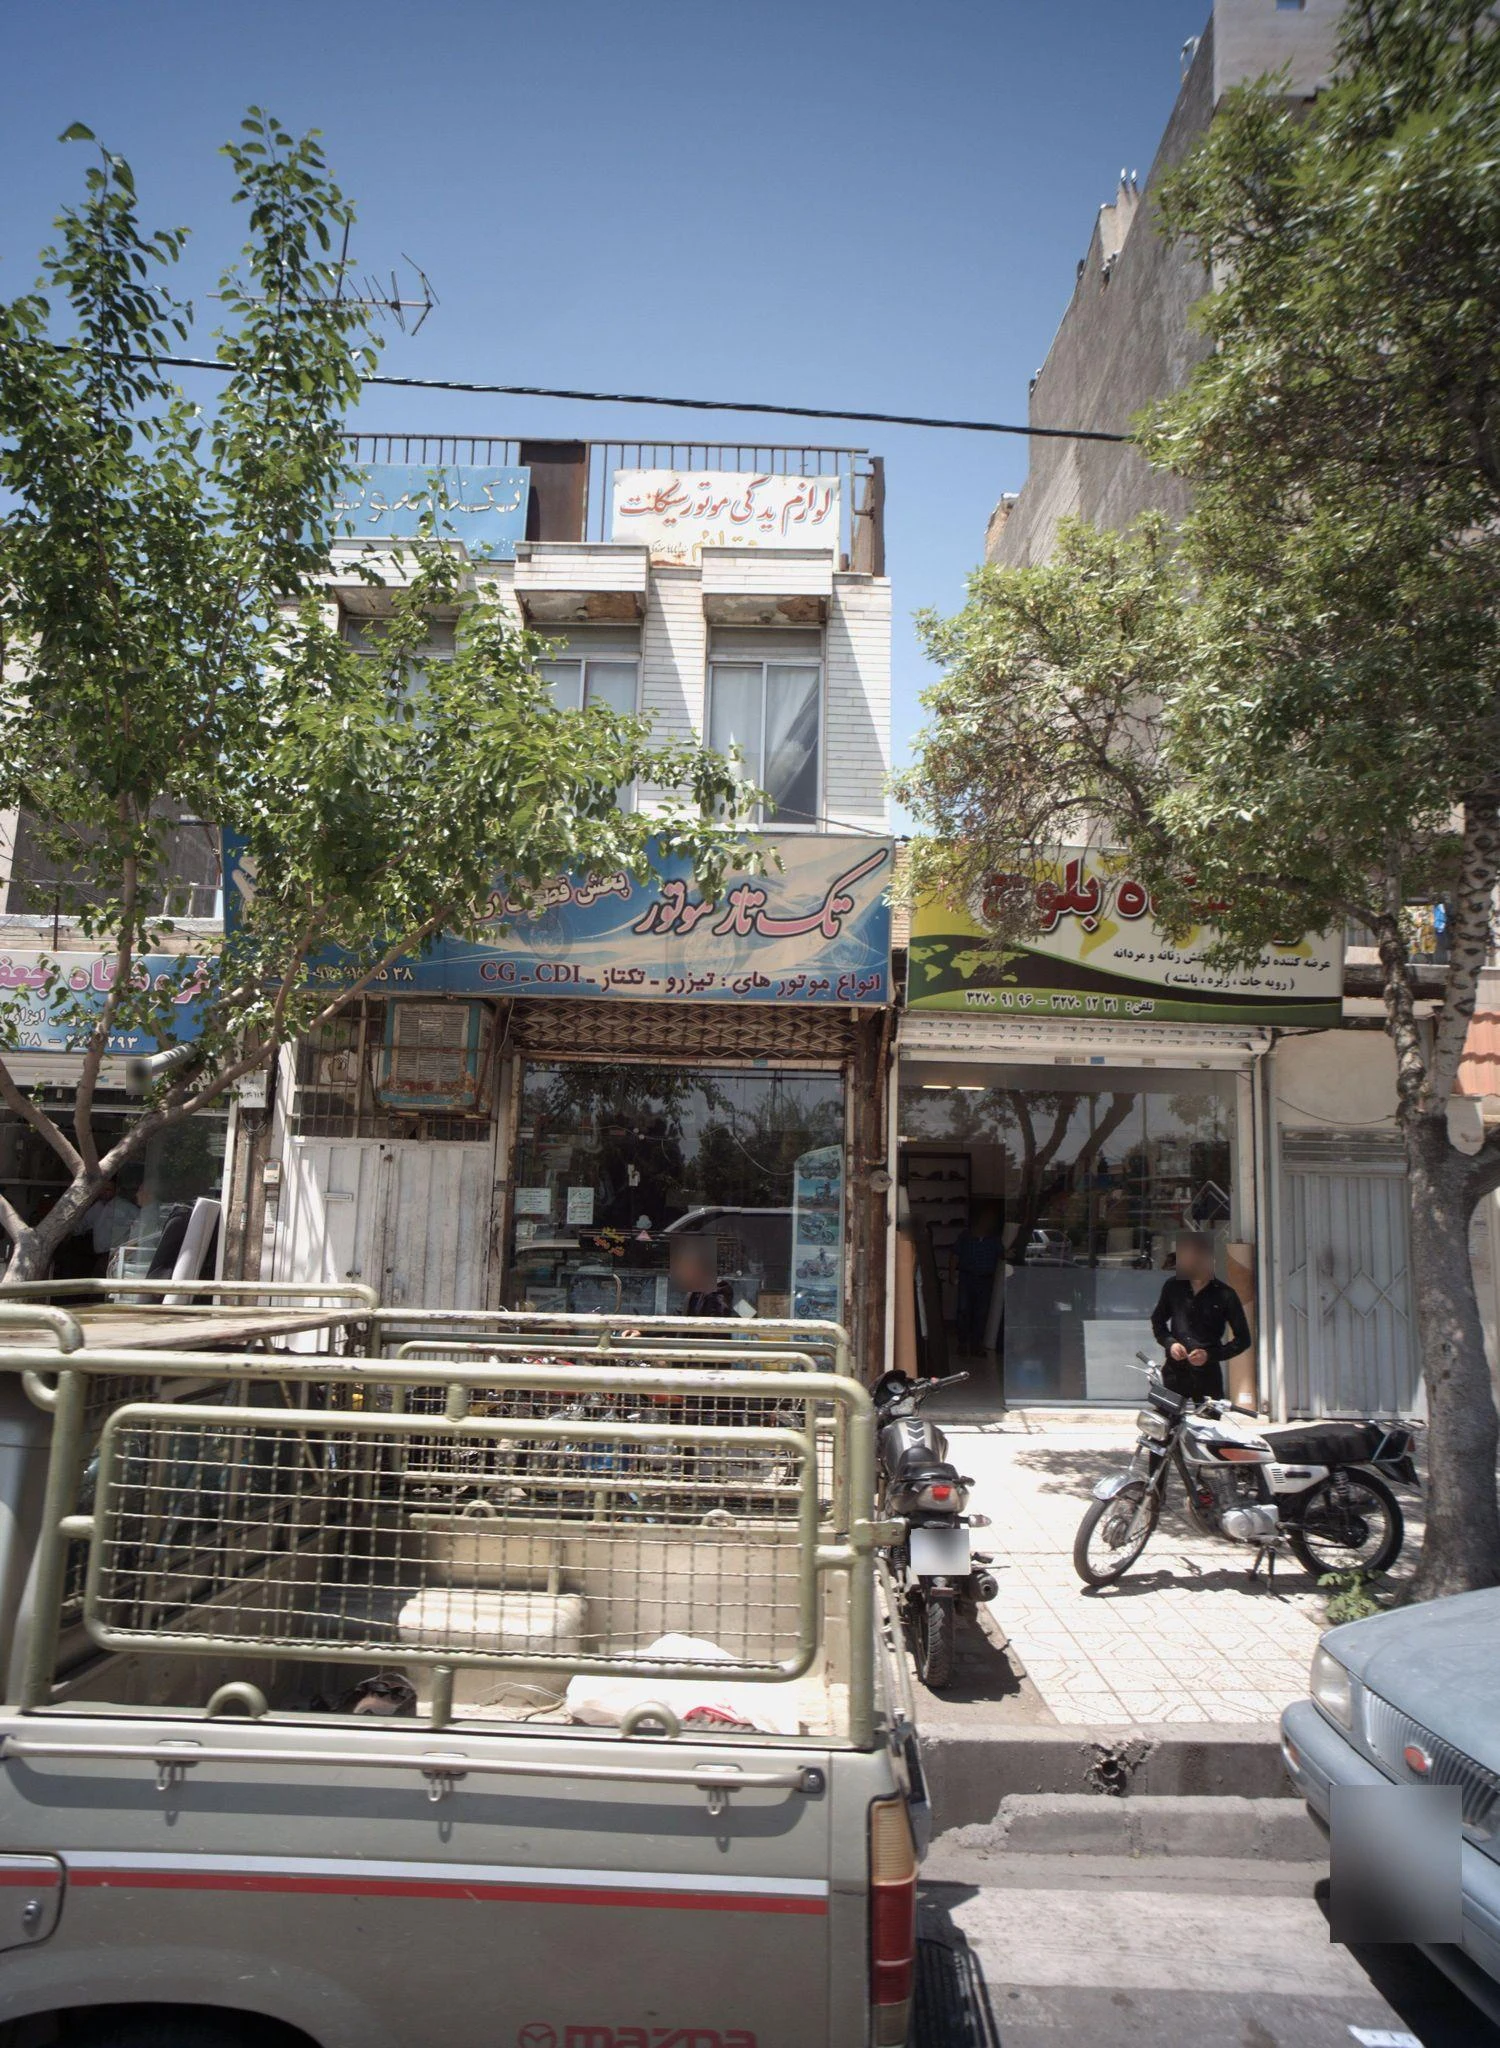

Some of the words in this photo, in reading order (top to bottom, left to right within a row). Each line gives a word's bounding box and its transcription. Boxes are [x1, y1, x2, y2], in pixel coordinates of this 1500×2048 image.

[729, 475, 777, 532] یدکی
[781, 482, 834, 536] لوازم
[632, 880, 716, 936] موتور
[1113, 948, 1145, 962] مردانه
[1157, 950, 1181, 964] زنانه
[1273, 956, 1301, 968] کننده
[1304, 958, 1332, 971] عرضه
[480, 961, 516, 982] CG
[535, 963, 581, 984] CDI
[601, 967, 646, 992] تکتاز
[732, 970, 771, 994] های
[665, 972, 716, 994] تیزرو
[776, 973, 830, 996] موتور
[836, 973, 881, 1001] انواع
[965, 990, 997, 1007] ۳۲۷۰
[1001, 992, 1014, 1007] ۹۱
[1051, 995, 1081, 1009] ۳۲۷۰
[1085, 996, 1099, 1011] ۱۲
[1103, 998, 1118, 1013] ۳۱
